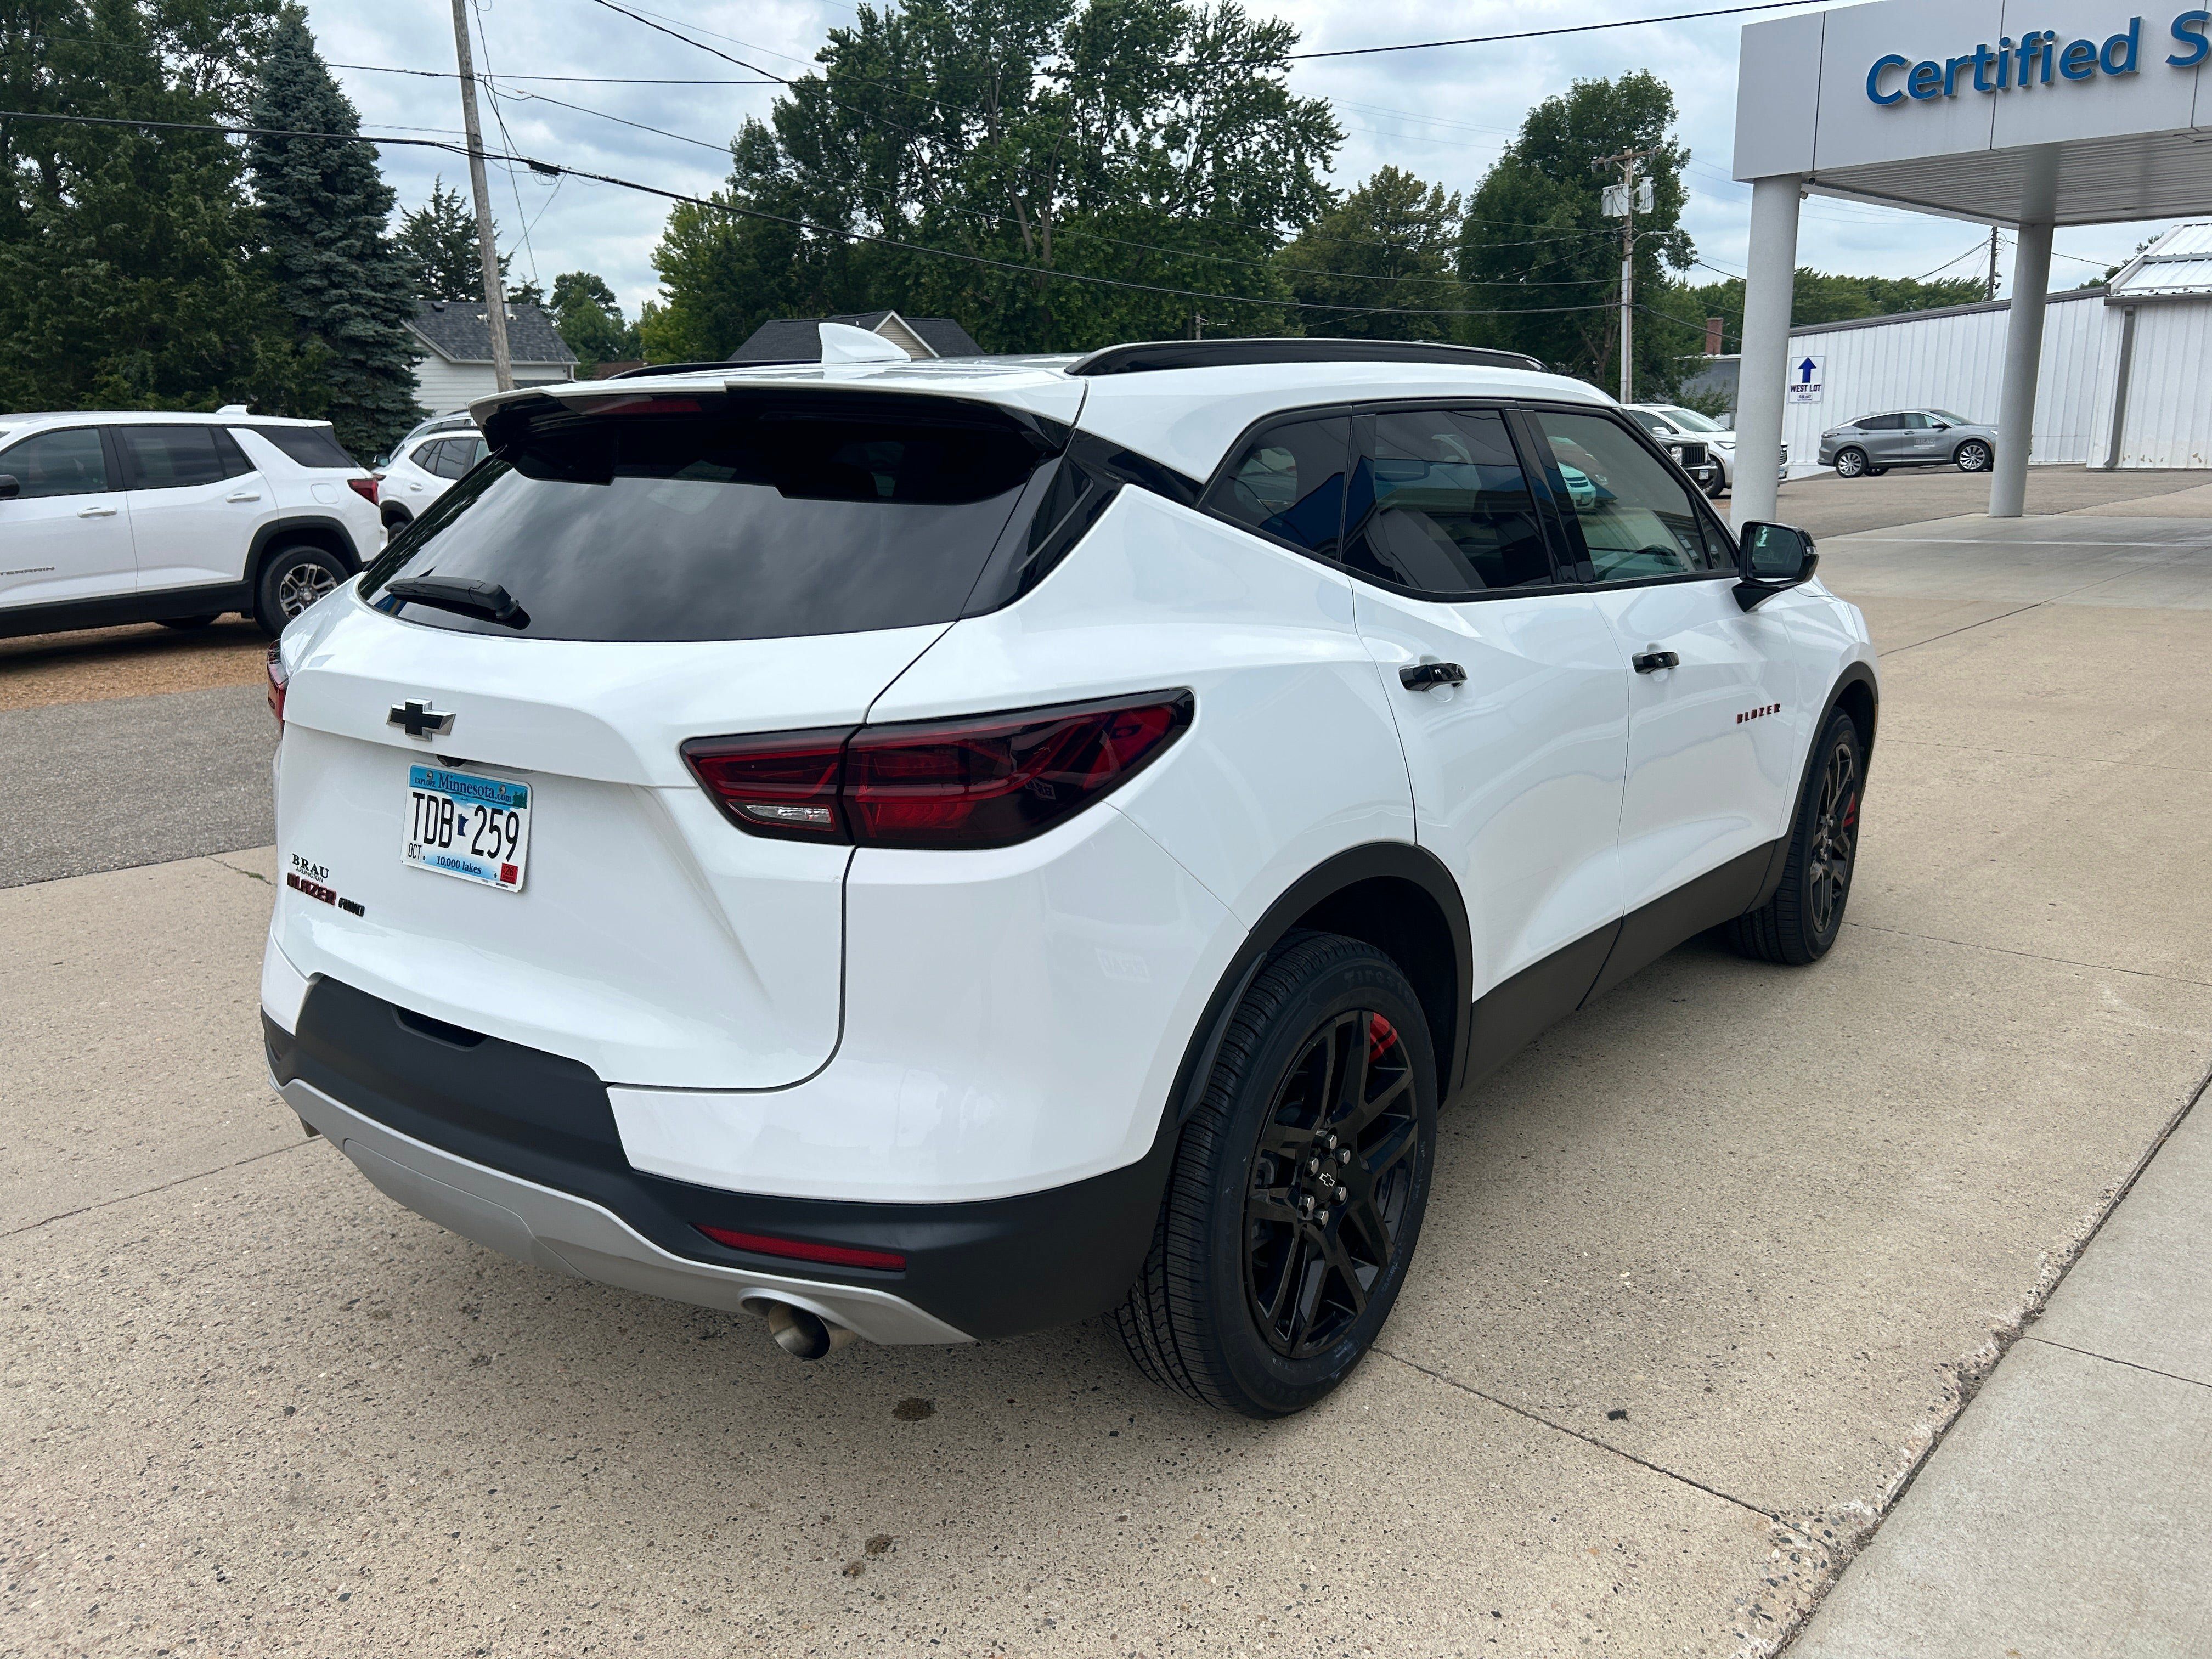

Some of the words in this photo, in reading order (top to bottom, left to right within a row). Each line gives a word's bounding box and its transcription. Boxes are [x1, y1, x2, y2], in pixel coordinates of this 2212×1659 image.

[1866, 16, 2143, 106] Certified
[2165, 10, 2212, 67] S
[1736, 703, 1780, 724] BLAZER
[414, 777, 436, 787] EXPLORE
[413, 792, 454, 849] TDB
[471, 805, 520, 862] 259
[408, 843, 422, 860] OCT
[292, 853, 330, 878] BRAU
[296, 866, 324, 883] ARLINGTON
[437, 856, 460, 869] 10,000
[462, 861, 482, 874] lakes
[287, 872, 337, 906] BLAZER
